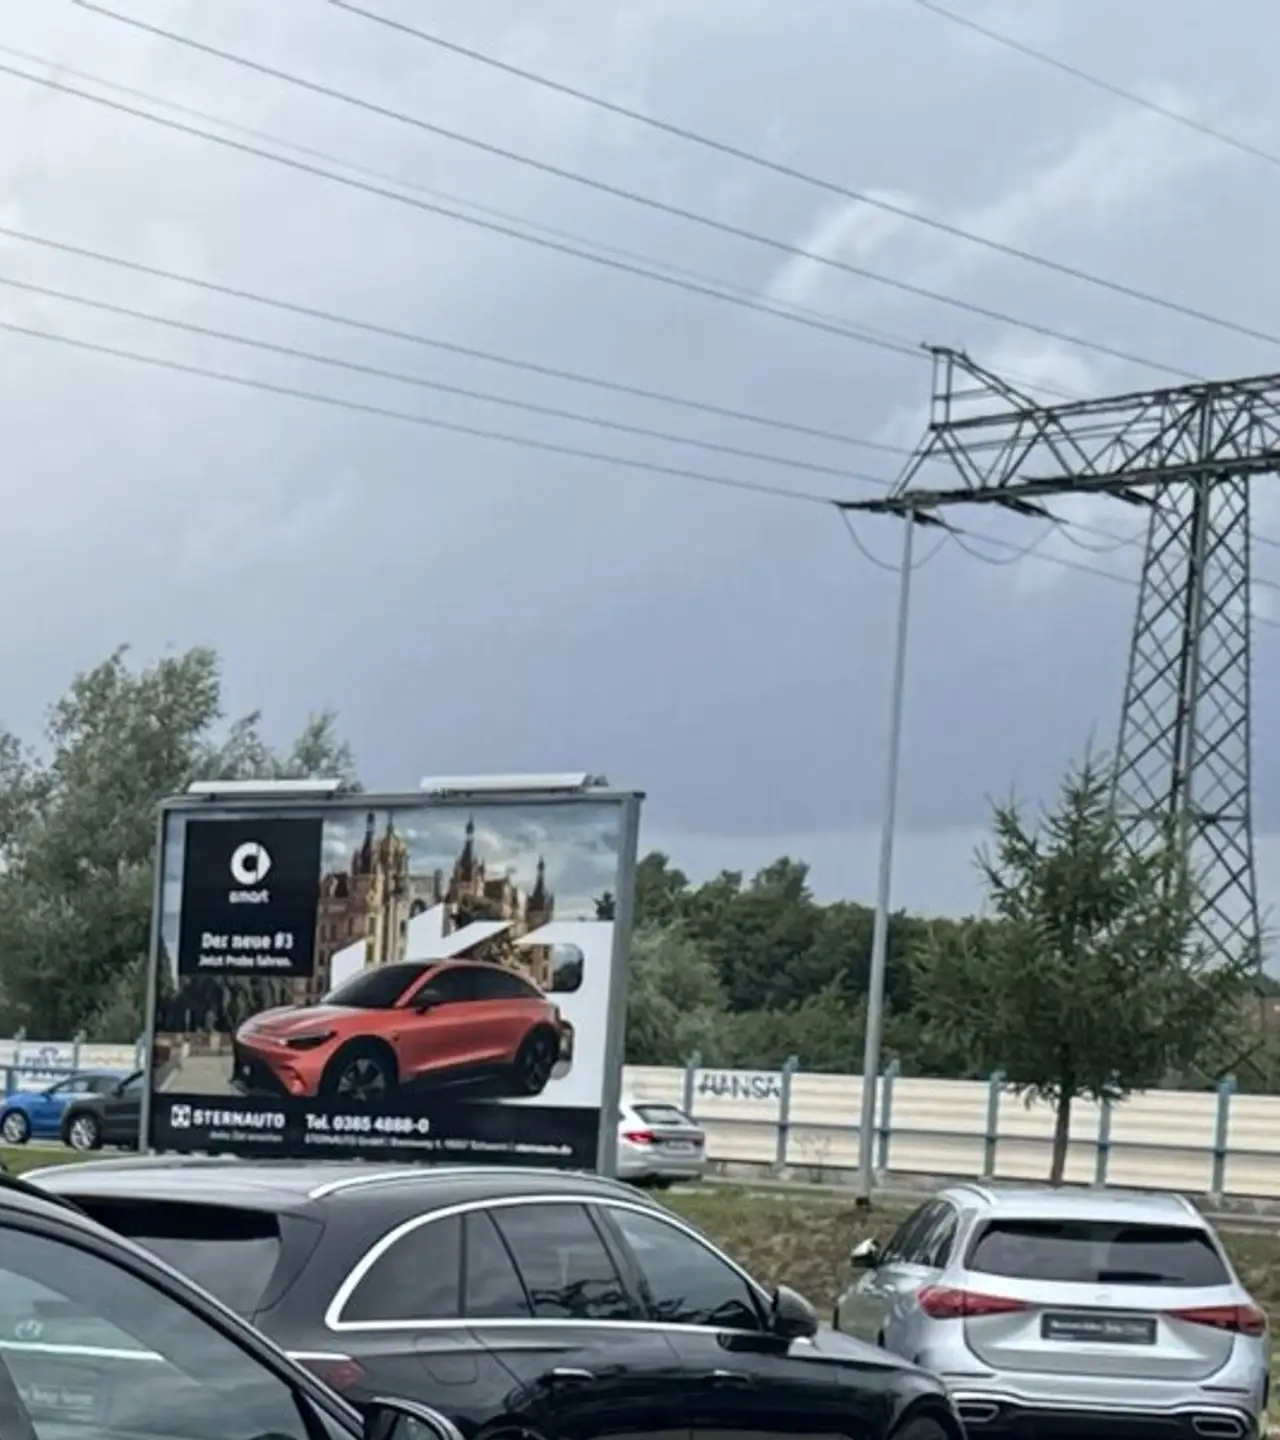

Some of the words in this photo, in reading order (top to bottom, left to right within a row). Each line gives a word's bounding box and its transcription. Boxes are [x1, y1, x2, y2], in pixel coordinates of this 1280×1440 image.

[228, 889, 270, 904] smart
[201, 932, 229, 949] Der
[231, 933, 272, 950] neue
[192, 1108, 286, 1129] STERNAUTO
[305, 1113, 330, 1131] Tel.
[332, 1114, 372, 1132] 0385
